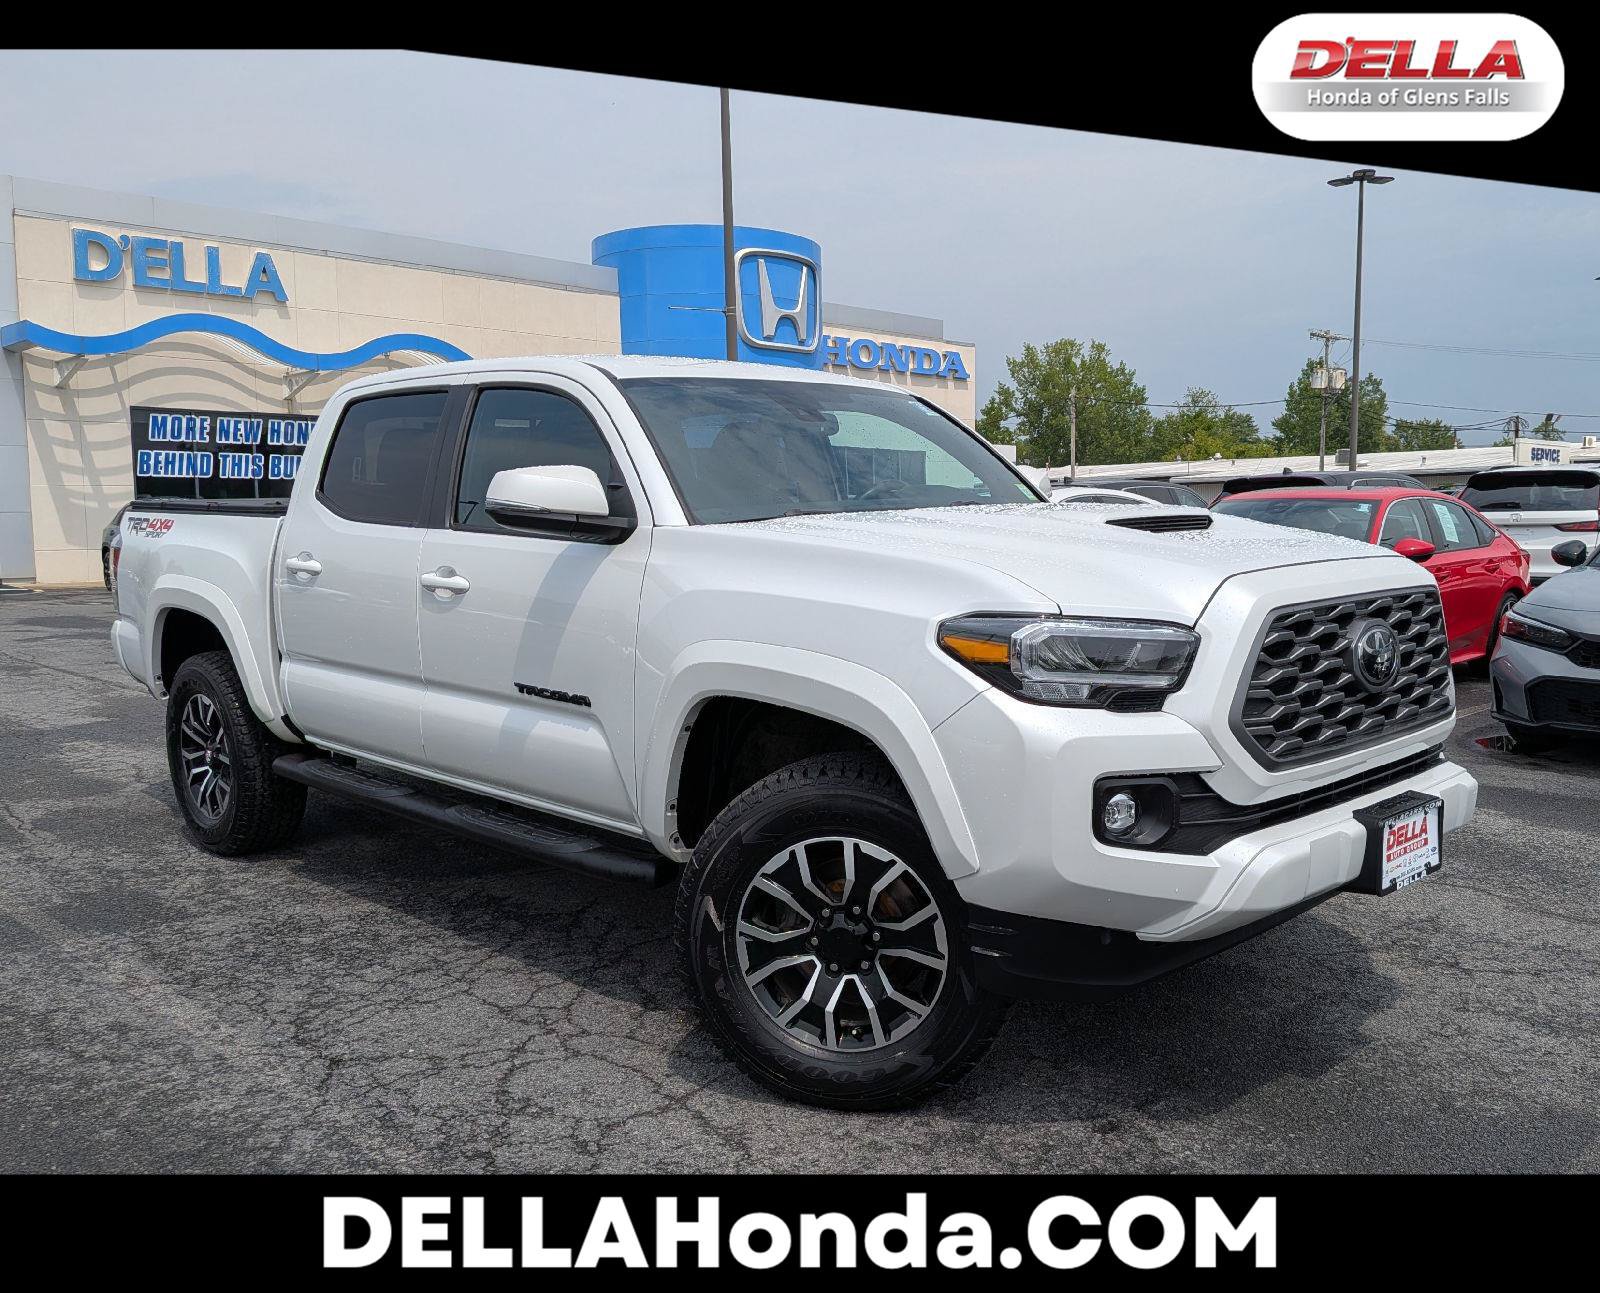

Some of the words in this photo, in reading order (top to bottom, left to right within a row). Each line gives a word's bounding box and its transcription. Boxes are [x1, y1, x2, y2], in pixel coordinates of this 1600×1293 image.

[822, 334, 970, 380] HONDA
[149, 413, 210, 443] MORE
[216, 416, 263, 445] NEW
[267, 418, 317, 446] HON
[137, 450, 213, 478] BEHIND
[219, 452, 264, 480] THIS
[1530, 447, 1561, 464] SERVICE
[144, 530, 168, 539] SPORT
[513, 681, 592, 708] TACOMA
[1390, 848, 1405, 861] AUTO
[1406, 840, 1425, 854] GROUP
